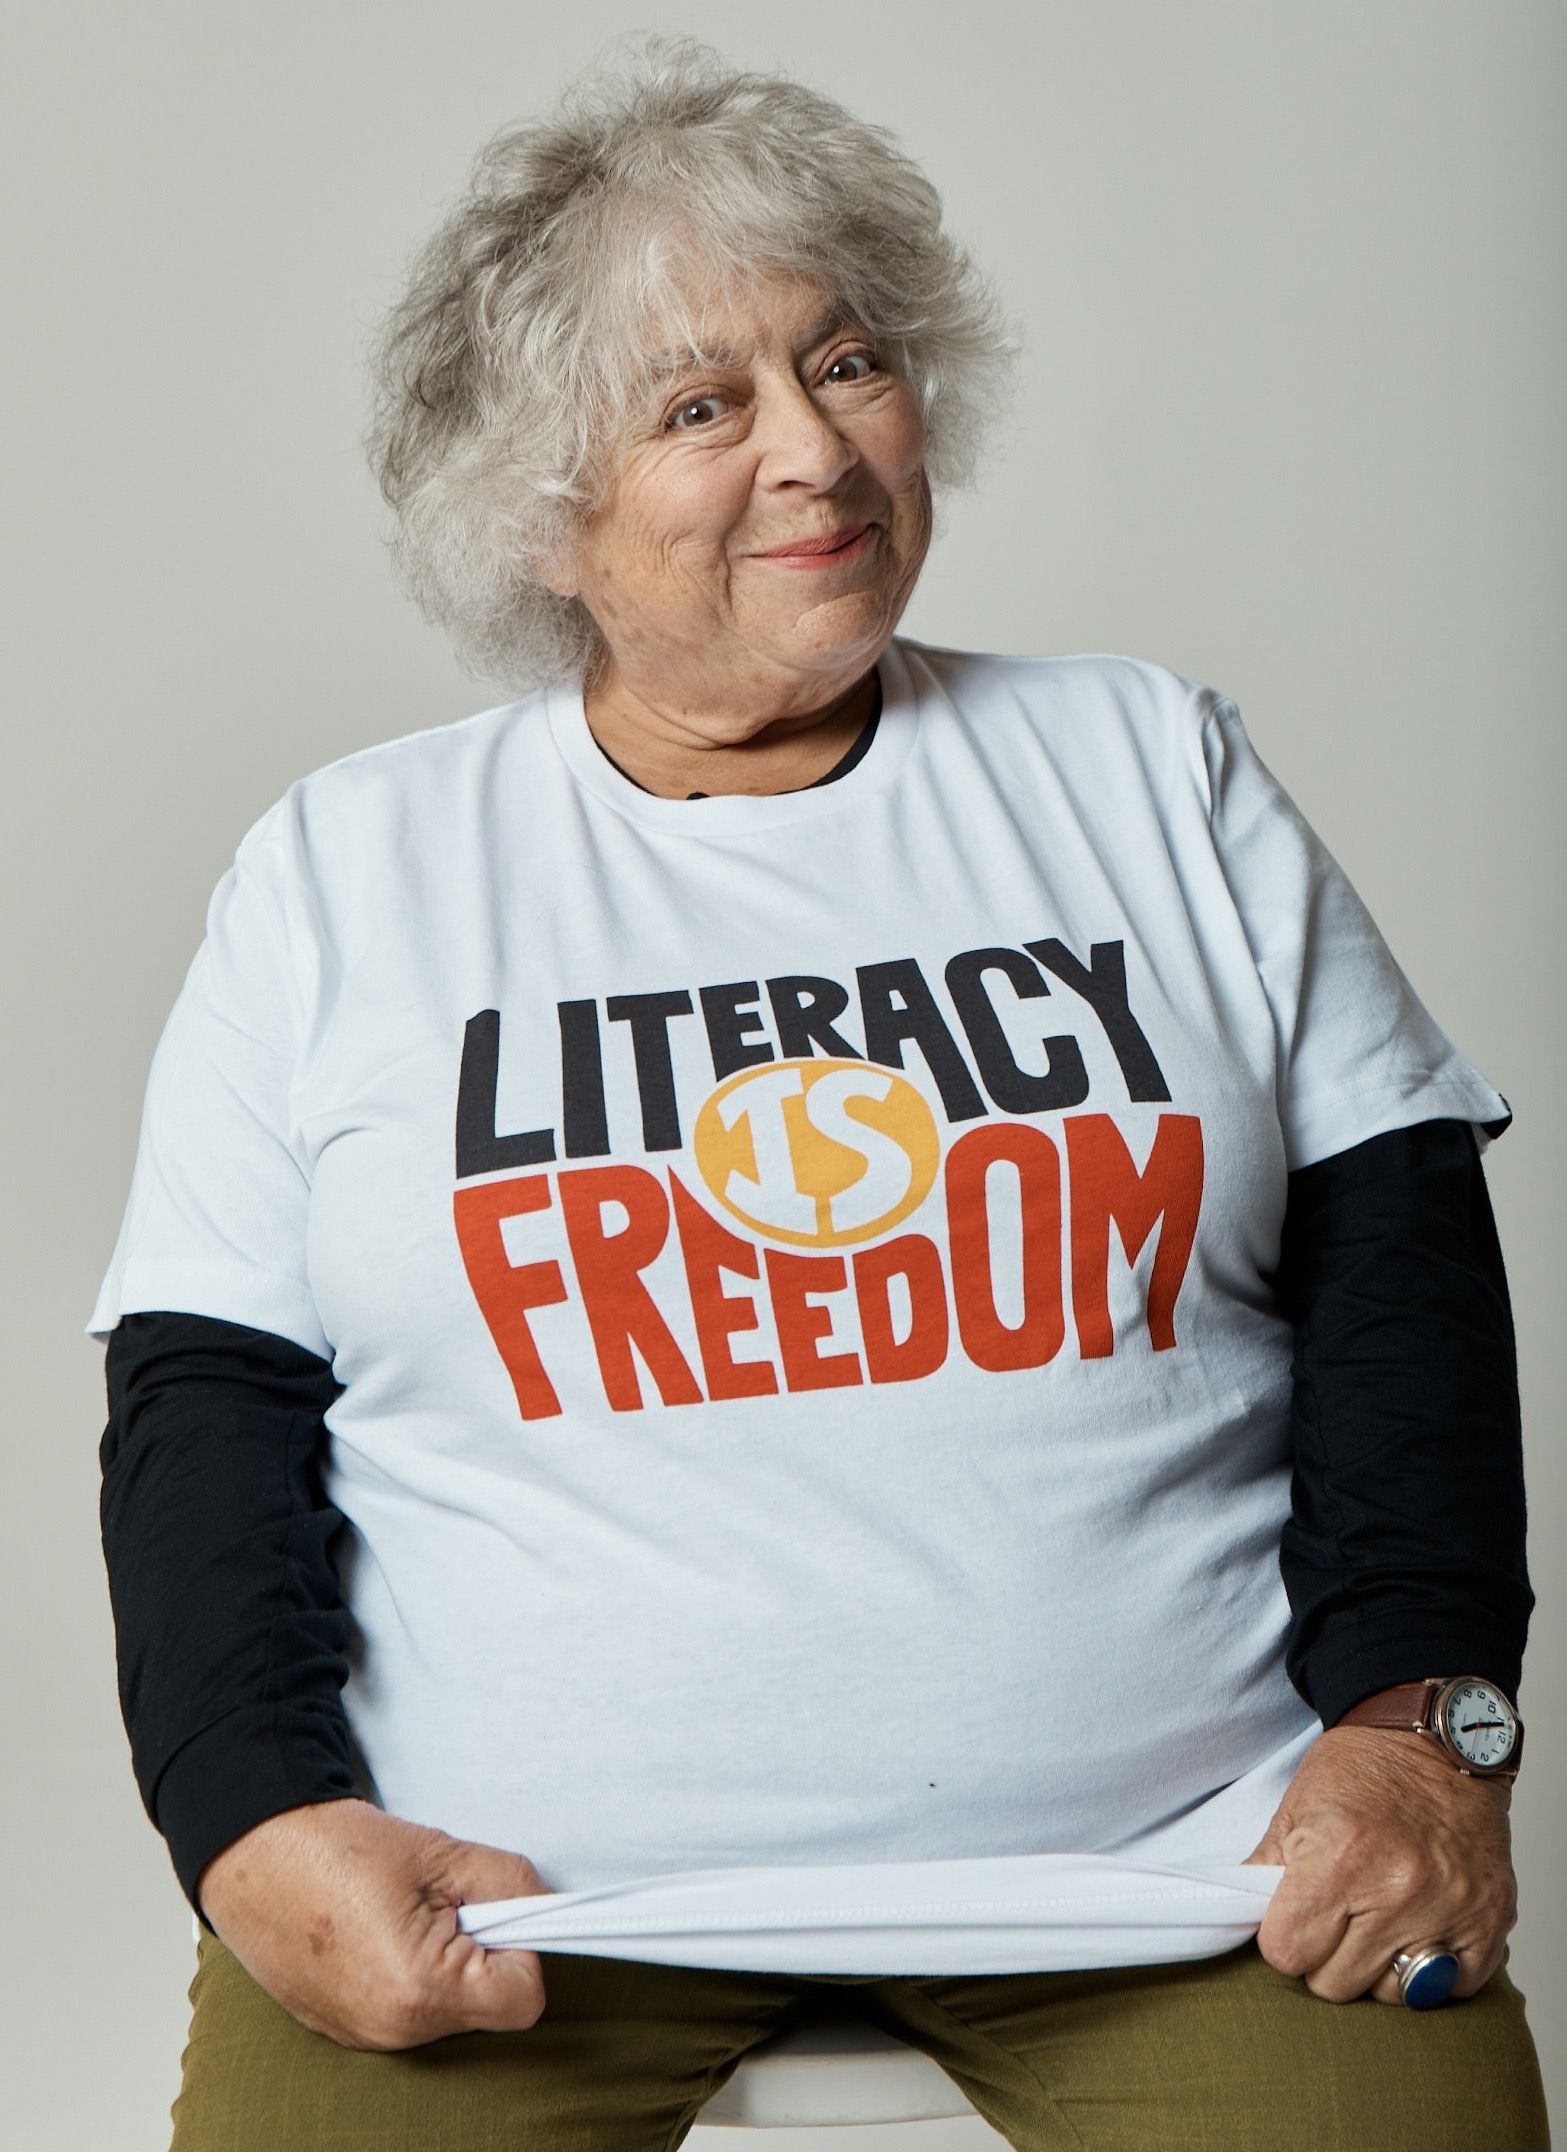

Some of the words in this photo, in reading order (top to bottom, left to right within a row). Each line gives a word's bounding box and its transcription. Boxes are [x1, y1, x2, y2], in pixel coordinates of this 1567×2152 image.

[456, 939, 1172, 1179] LITERACY
[716, 1068, 912, 1235] IS
[454, 1113, 1204, 1420] FREEDOM
[1464, 1689, 1472, 1698] 8
[1477, 1690, 1486, 1699] 9
[1488, 1700, 1497, 1714] 10
[1497, 1731, 1506, 1744] 12
[1467, 1752, 1475, 1760] 3
[1481, 1753, 1490, 1762] 2
